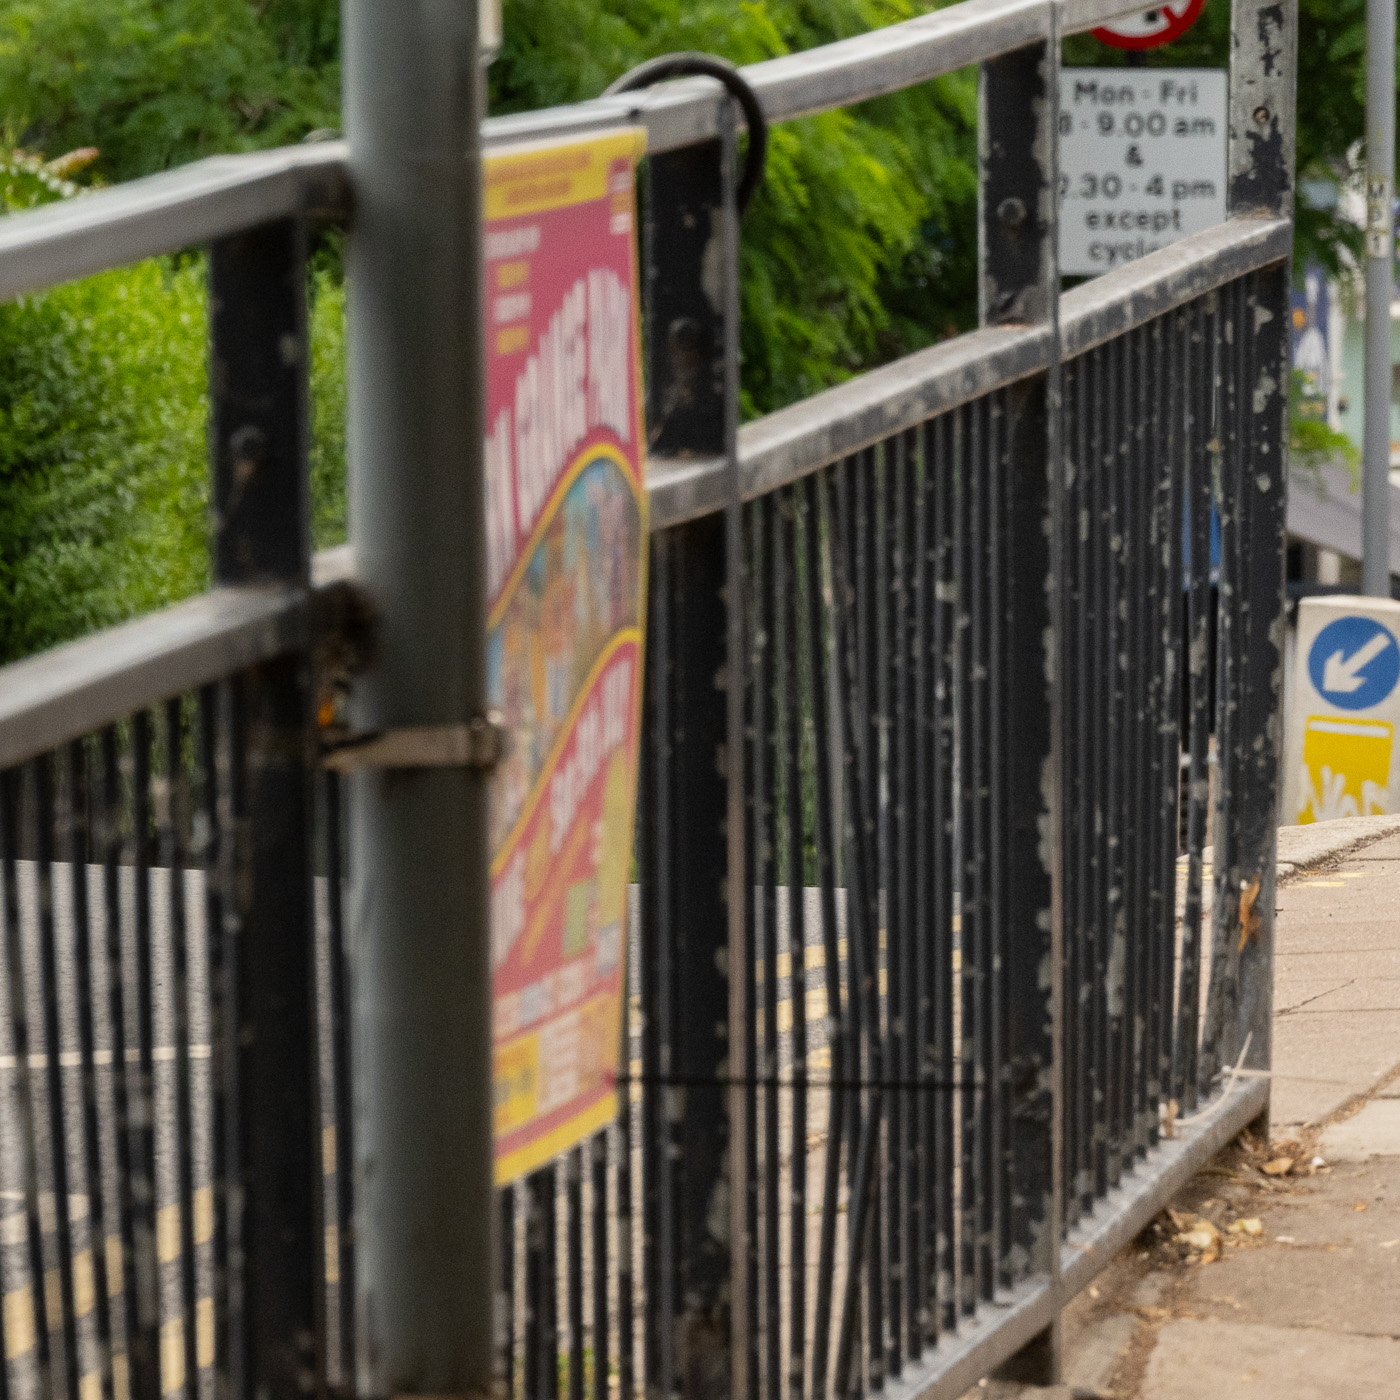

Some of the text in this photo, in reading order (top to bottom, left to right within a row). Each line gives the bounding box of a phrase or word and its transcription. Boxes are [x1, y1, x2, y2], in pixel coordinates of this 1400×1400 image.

[1074, 79, 1135, 105] Mon
[1159, 79, 1198, 105] Fri
[1097, 110, 1166, 138] 9.00
[1173, 116, 1216, 137] am
[1124, 143, 1144, 168] &
[1144, 173, 1164, 197] 4
[1172, 179, 1216, 203] pm
[1085, 209, 1182, 234] except
